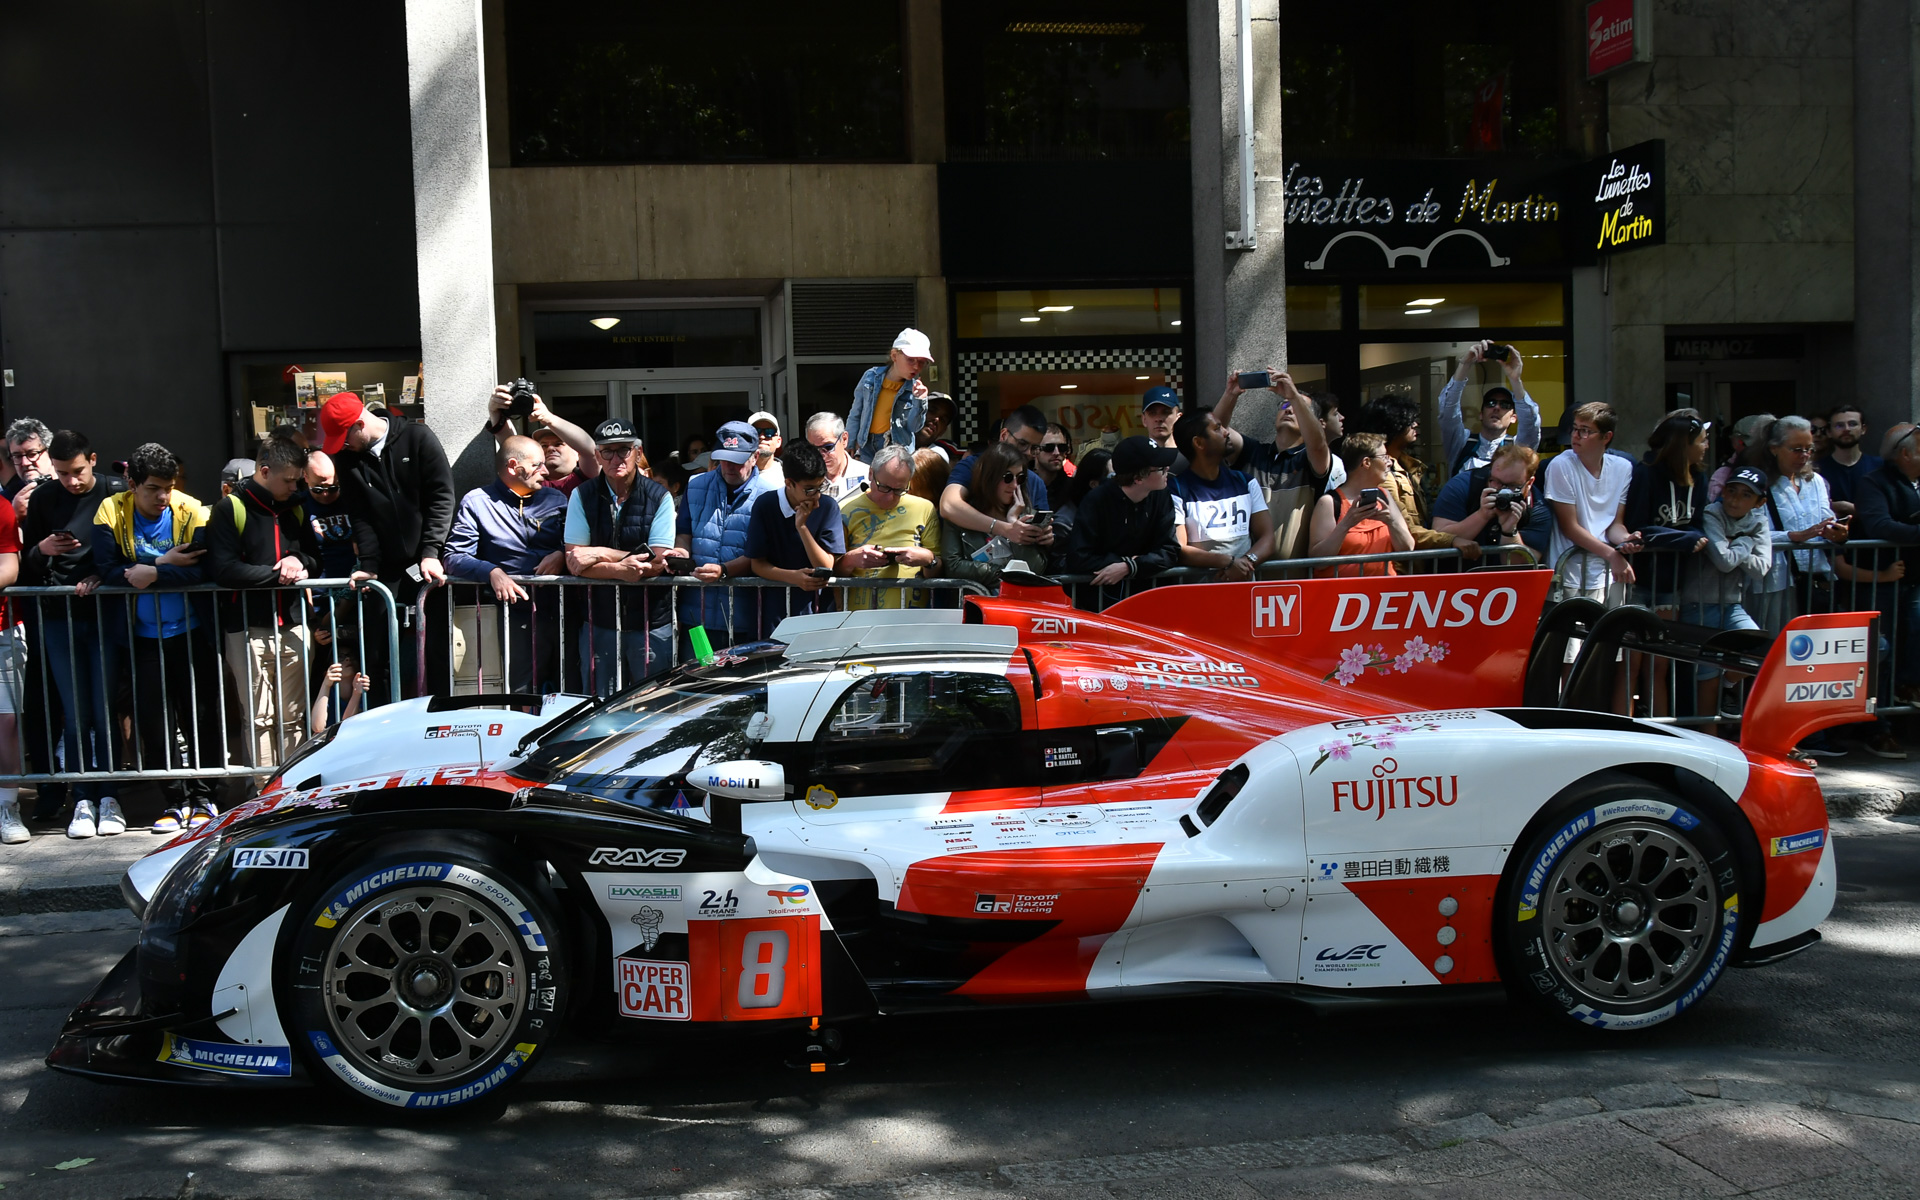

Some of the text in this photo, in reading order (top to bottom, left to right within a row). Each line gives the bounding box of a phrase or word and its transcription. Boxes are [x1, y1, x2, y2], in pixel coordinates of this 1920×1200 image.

[1590, 16, 1633, 57] Satim
[1284, 162, 1324, 196] Les
[1608, 159, 1625, 180] Les
[1595, 164, 1651, 203] Lunettes
[1406, 188, 1442, 224] de
[1455, 178, 1559, 224] Martin
[1620, 194, 1634, 217] de
[1597, 208, 1652, 249] Martin
[1674, 340, 1755, 356] MERMOZ
[1206, 501, 1247, 529] 24h
[1255, 594, 1298, 628] HY
[1330, 587, 1518, 632] DENSO
[1031, 618, 1080, 634] ZENT
[1816, 639, 1866, 655] JFE
[1135, 662, 1246, 673] RACING
[1080, 677, 1103, 691] FIA
[1143, 675, 1261, 690] HYBRID
[1788, 682, 1854, 702] ADVICS
[425, 730, 450, 739] GR
[487, 723, 504, 737] 8
[708, 776, 745, 788] Mobil
[1331, 774, 1458, 821] FUJITSU
[1602, 804, 1666, 817] #WeRaceForChange
[1789, 835, 1820, 849] MICHELIN
[235, 850, 307, 868] AISIN
[588, 847, 687, 867] RAYS
[1529, 816, 1590, 889] MICHELIN
[1344, 855, 1450, 879] 豊田自動織機
[346, 865, 442, 904] MICHELIN
[456, 872, 515, 908] PILOT SPORT
[611, 888, 680, 897] HAYASHI
[700, 889, 739, 909] 24h
[976, 902, 1011, 912] GR
[768, 907, 810, 915] TotalEnergies
[1316, 945, 1388, 961] WEC
[623, 963, 683, 985] HYPER
[738, 930, 790, 1009] 8
[1682, 929, 1734, 1008] MICHELIN
[624, 983, 685, 1014] CAR
[1615, 1010, 1670, 1028] PILOT SPORT
[194, 1049, 279, 1068] MICHELIN
[335, 1062, 401, 1102] #WeRaceForChange
[416, 1066, 508, 1107] MICHELIN
